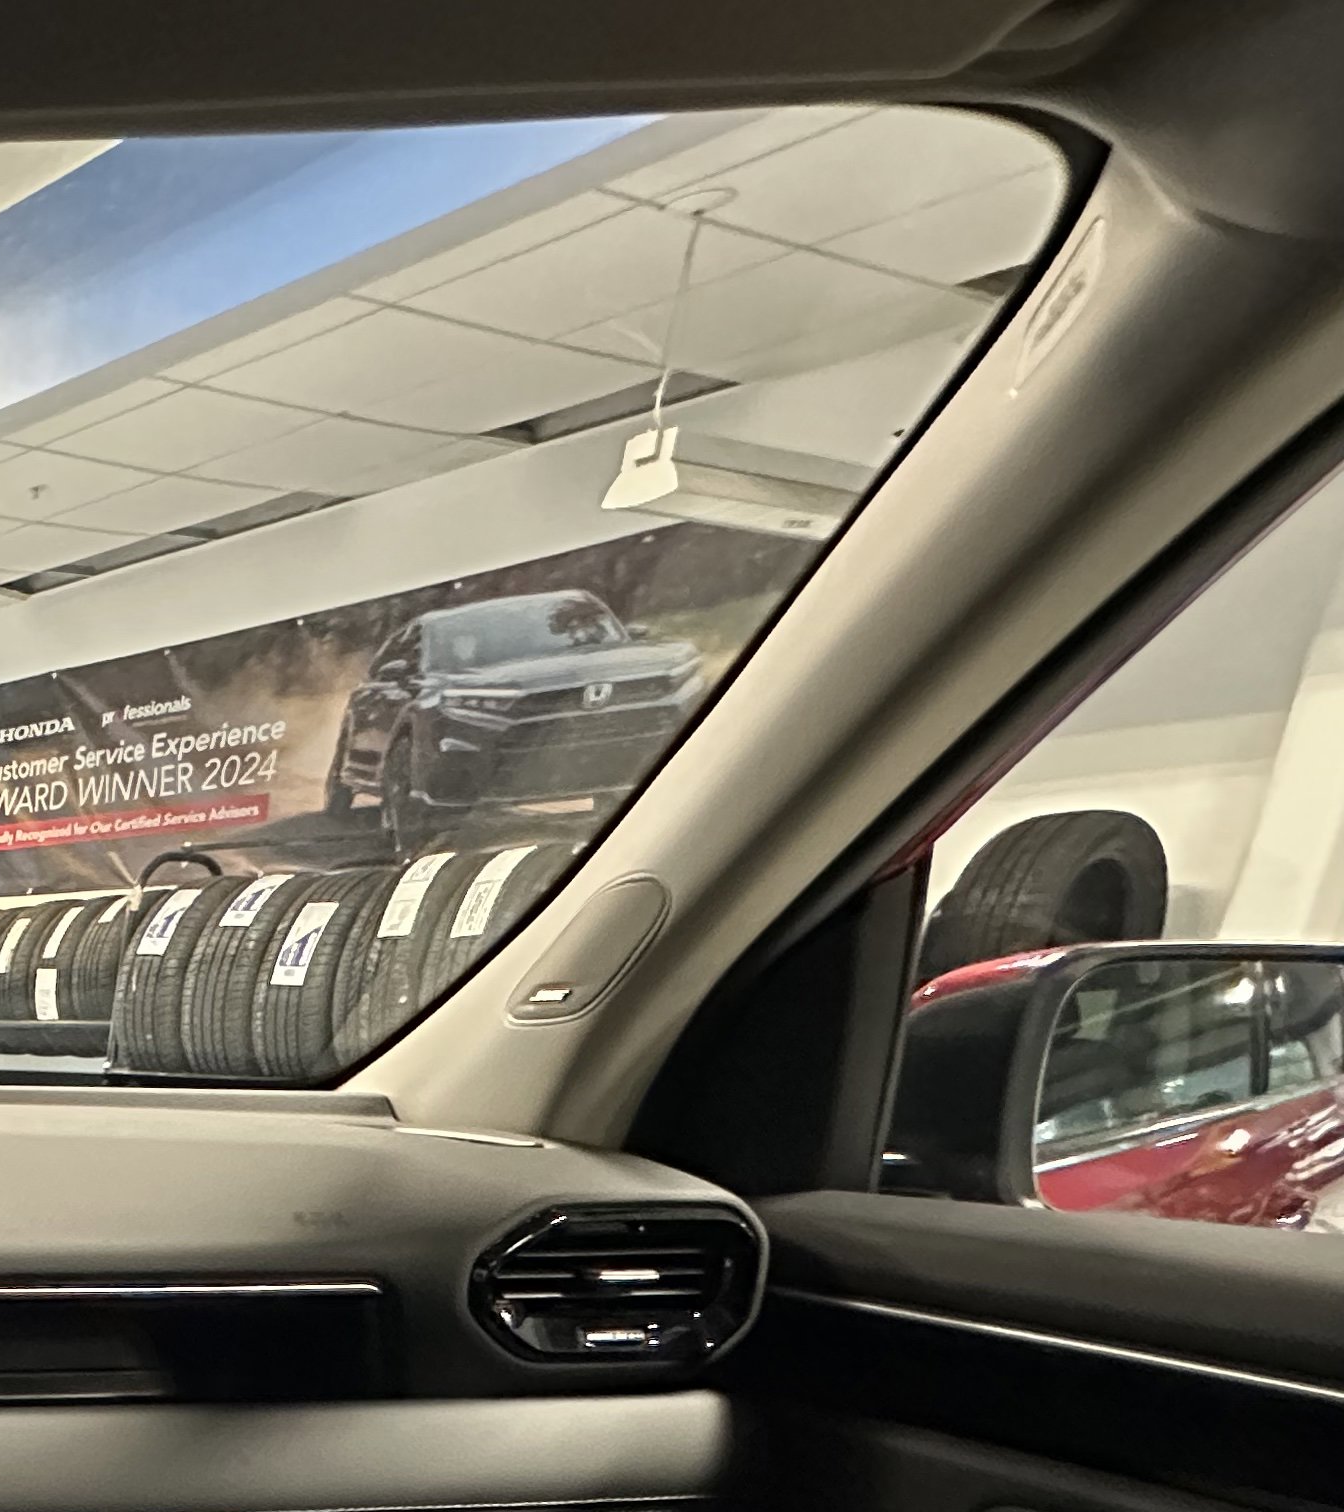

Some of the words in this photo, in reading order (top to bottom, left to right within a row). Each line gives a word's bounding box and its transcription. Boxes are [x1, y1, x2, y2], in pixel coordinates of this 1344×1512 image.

[73, 740, 146, 771] Service
[151, 720, 287, 761] Experience
[77, 762, 194, 808] WINNER
[200, 749, 279, 791] 2024
[74, 822, 89, 835] for
[89, 821, 113, 834] Our
[114, 814, 161, 832] Certified
[163, 811, 207, 827] Service
[208, 804, 260, 822] Advisors
